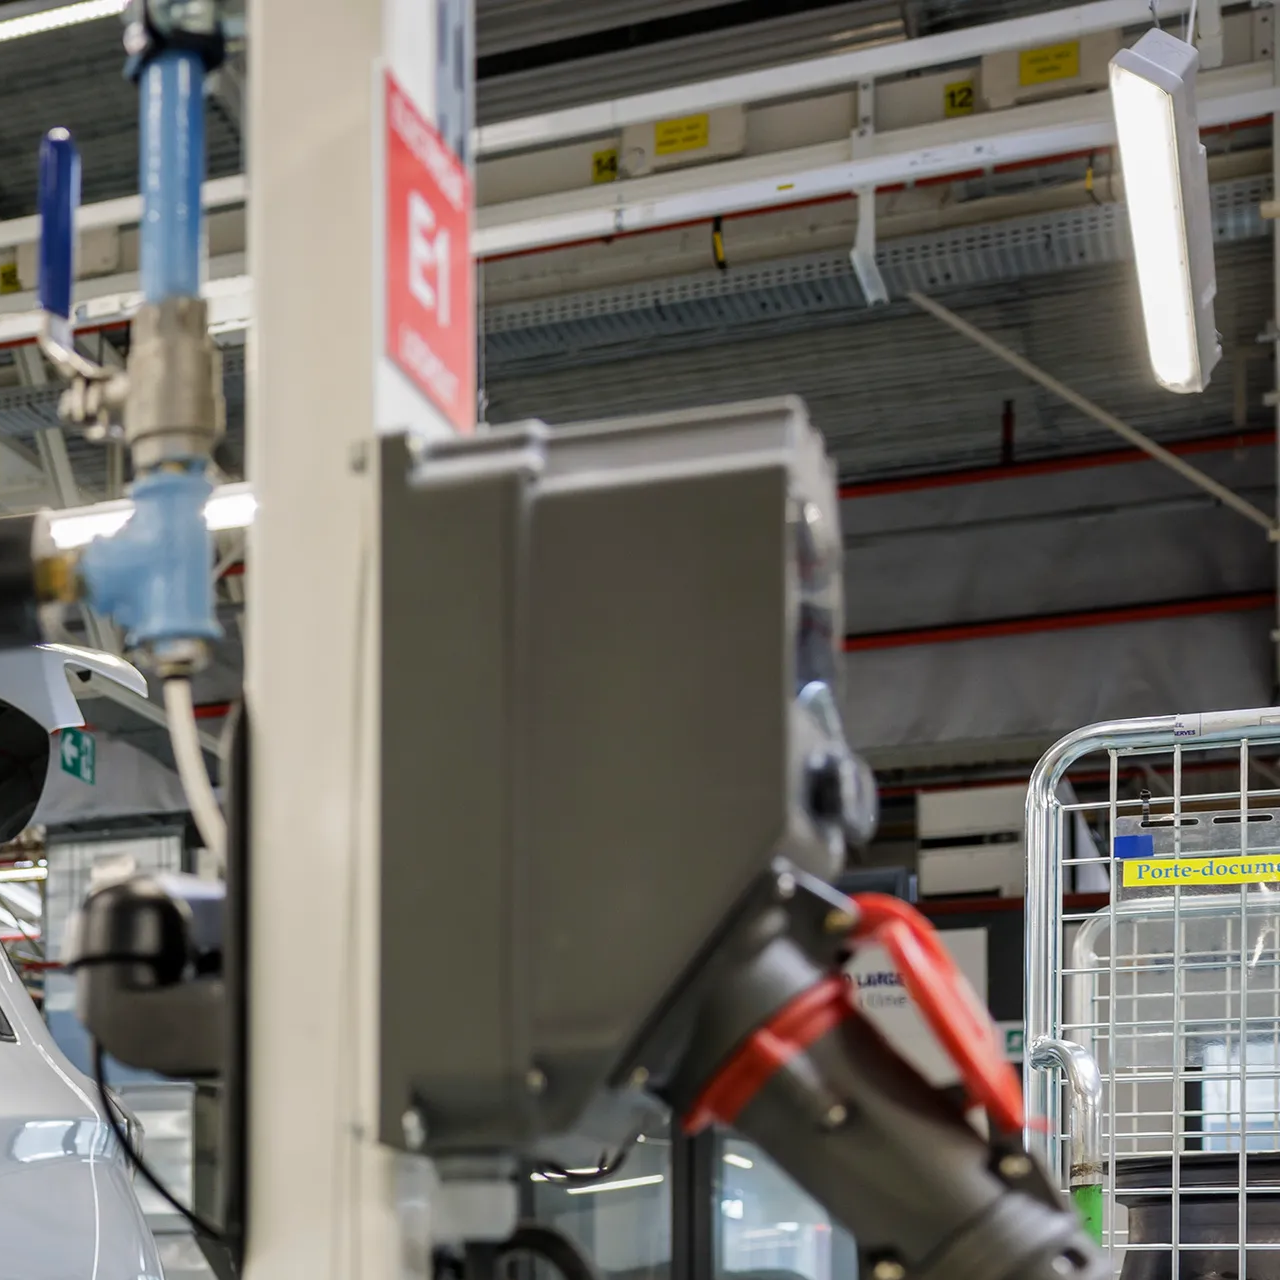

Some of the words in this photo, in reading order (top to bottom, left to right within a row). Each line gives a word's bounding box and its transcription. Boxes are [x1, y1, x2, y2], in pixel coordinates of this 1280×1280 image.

[949, 87, 973, 109] 12
[407, 187, 452, 328] E1
[1137, 859, 1280, 880] Porte-docum
